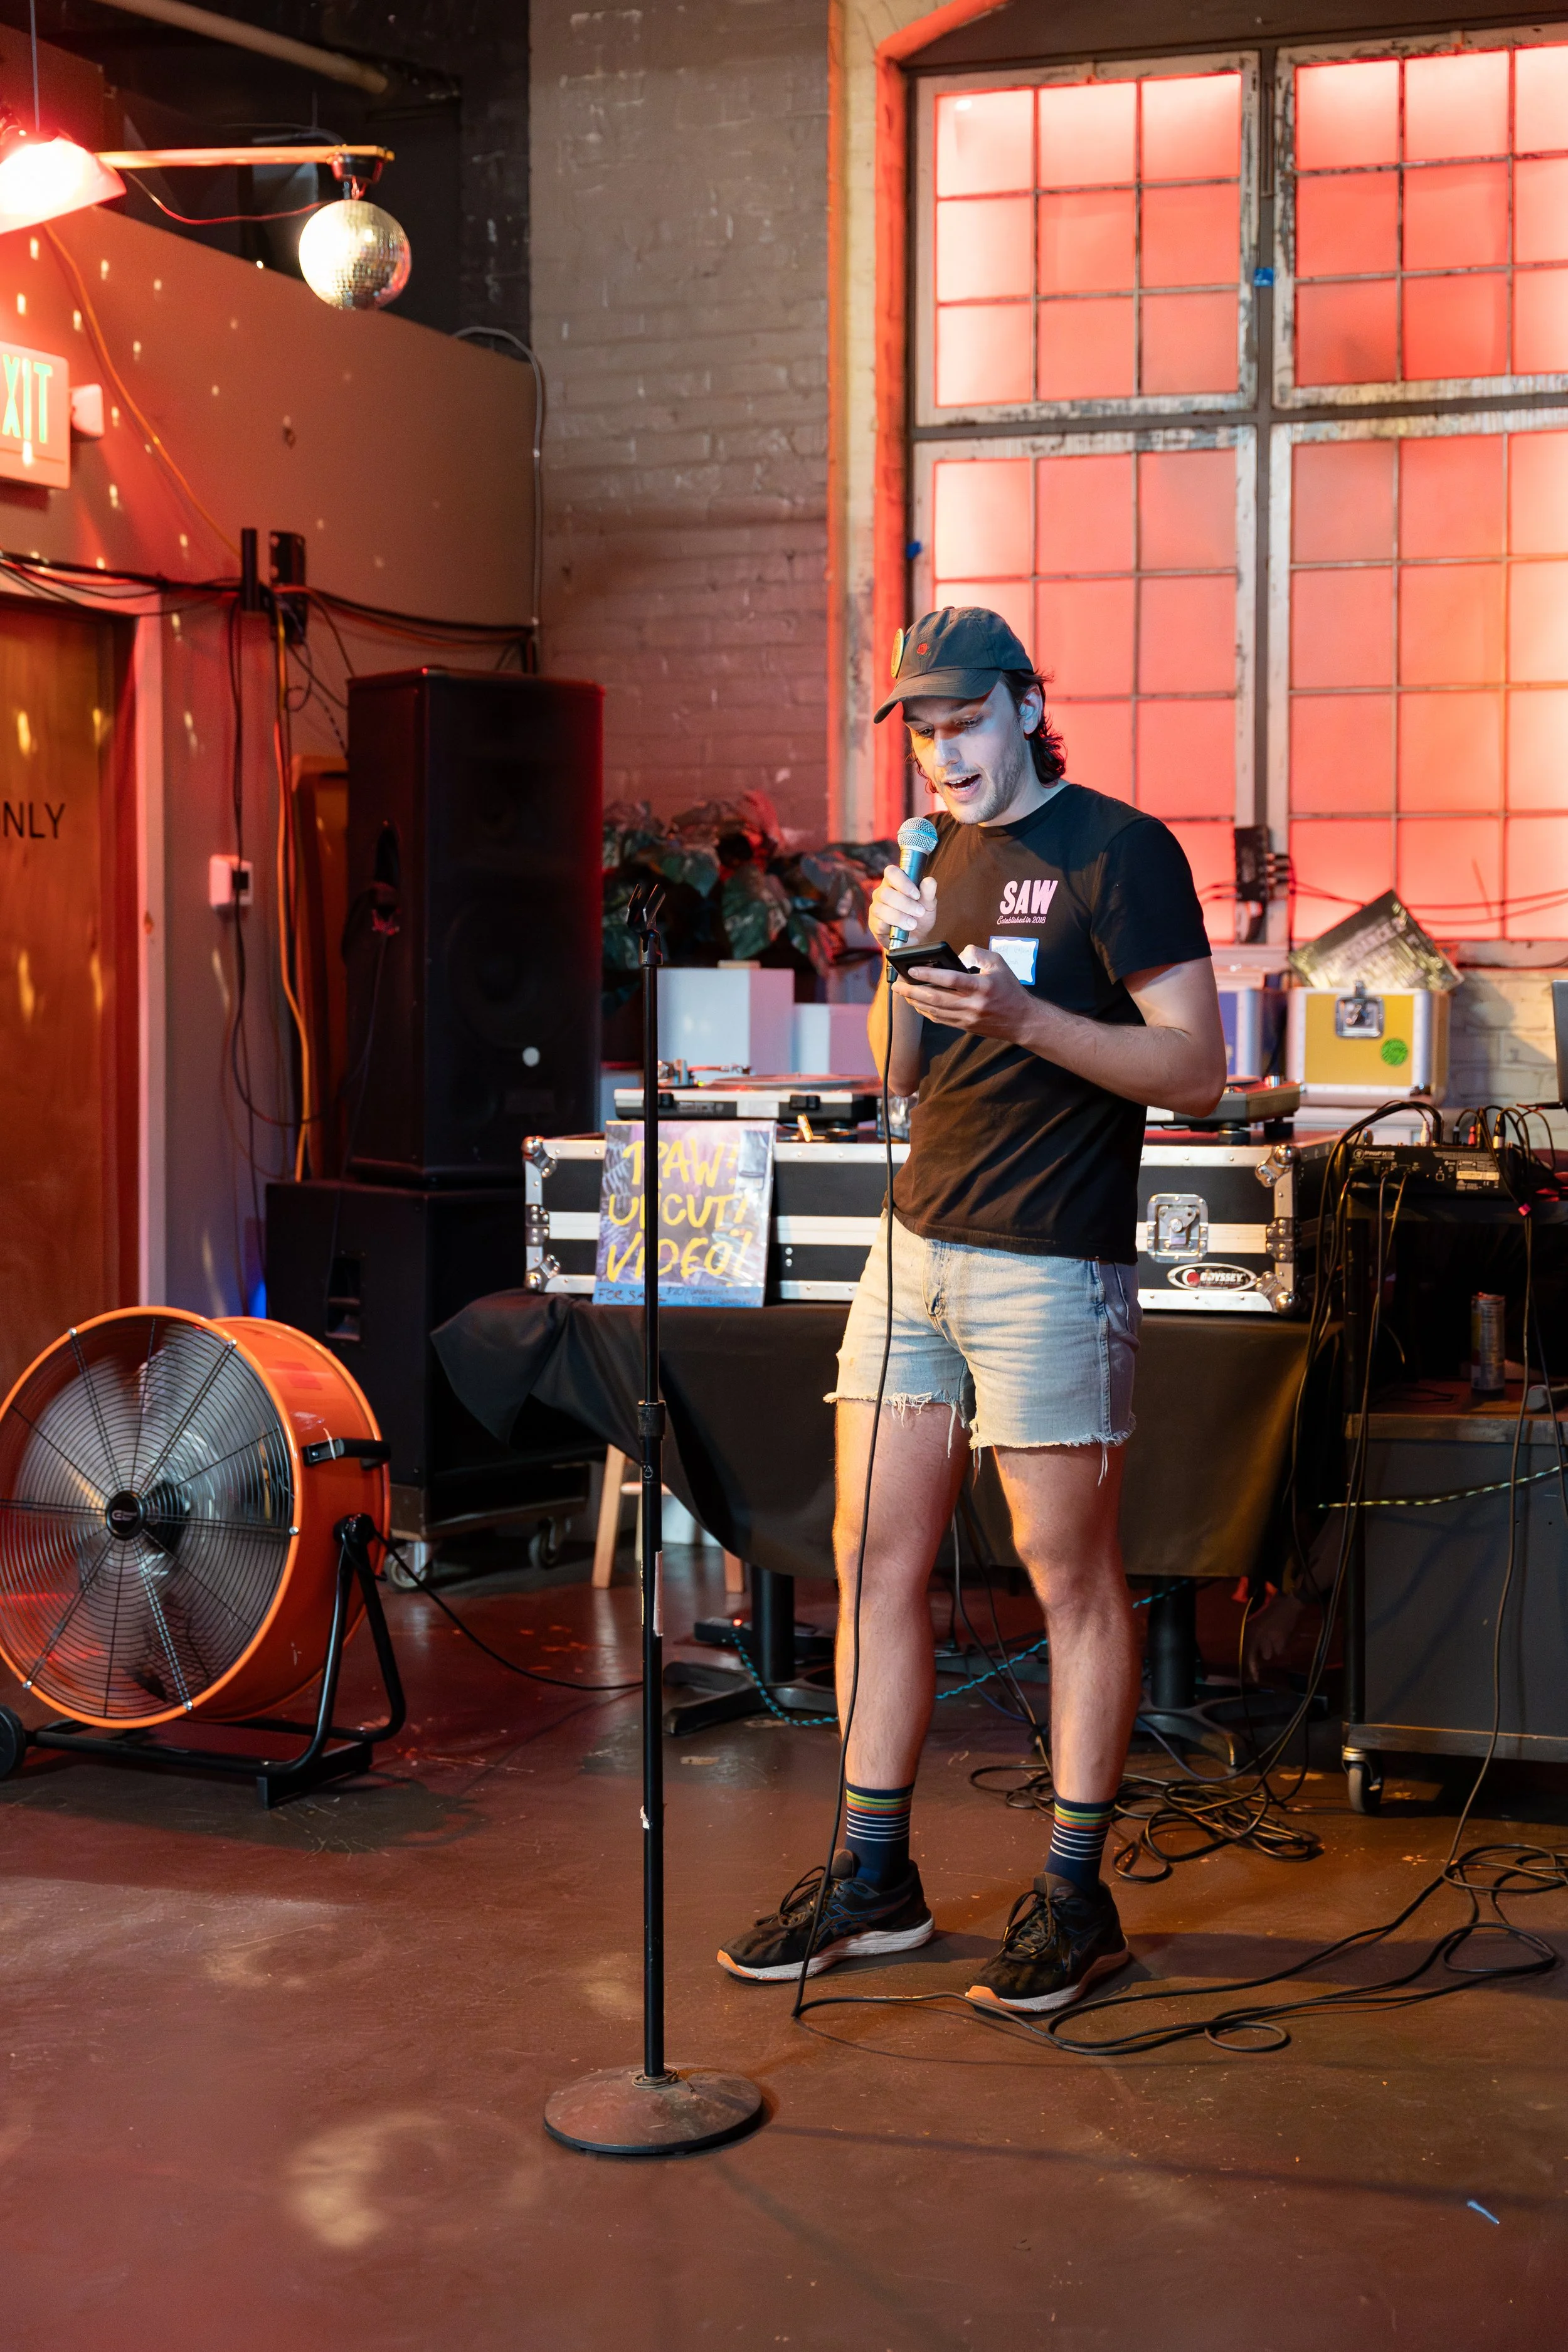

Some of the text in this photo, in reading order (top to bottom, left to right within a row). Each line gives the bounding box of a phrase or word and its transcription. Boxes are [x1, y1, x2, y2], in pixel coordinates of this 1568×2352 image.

[2, 353, 53, 444] XIT
[3, 800, 65, 839] NLY
[999, 879, 1059, 915] SAW
[997, 915, 1026, 924] Established
[1032, 916, 1046, 924] 2018
[1200, 1271, 1243, 1283] ODYSSEY
